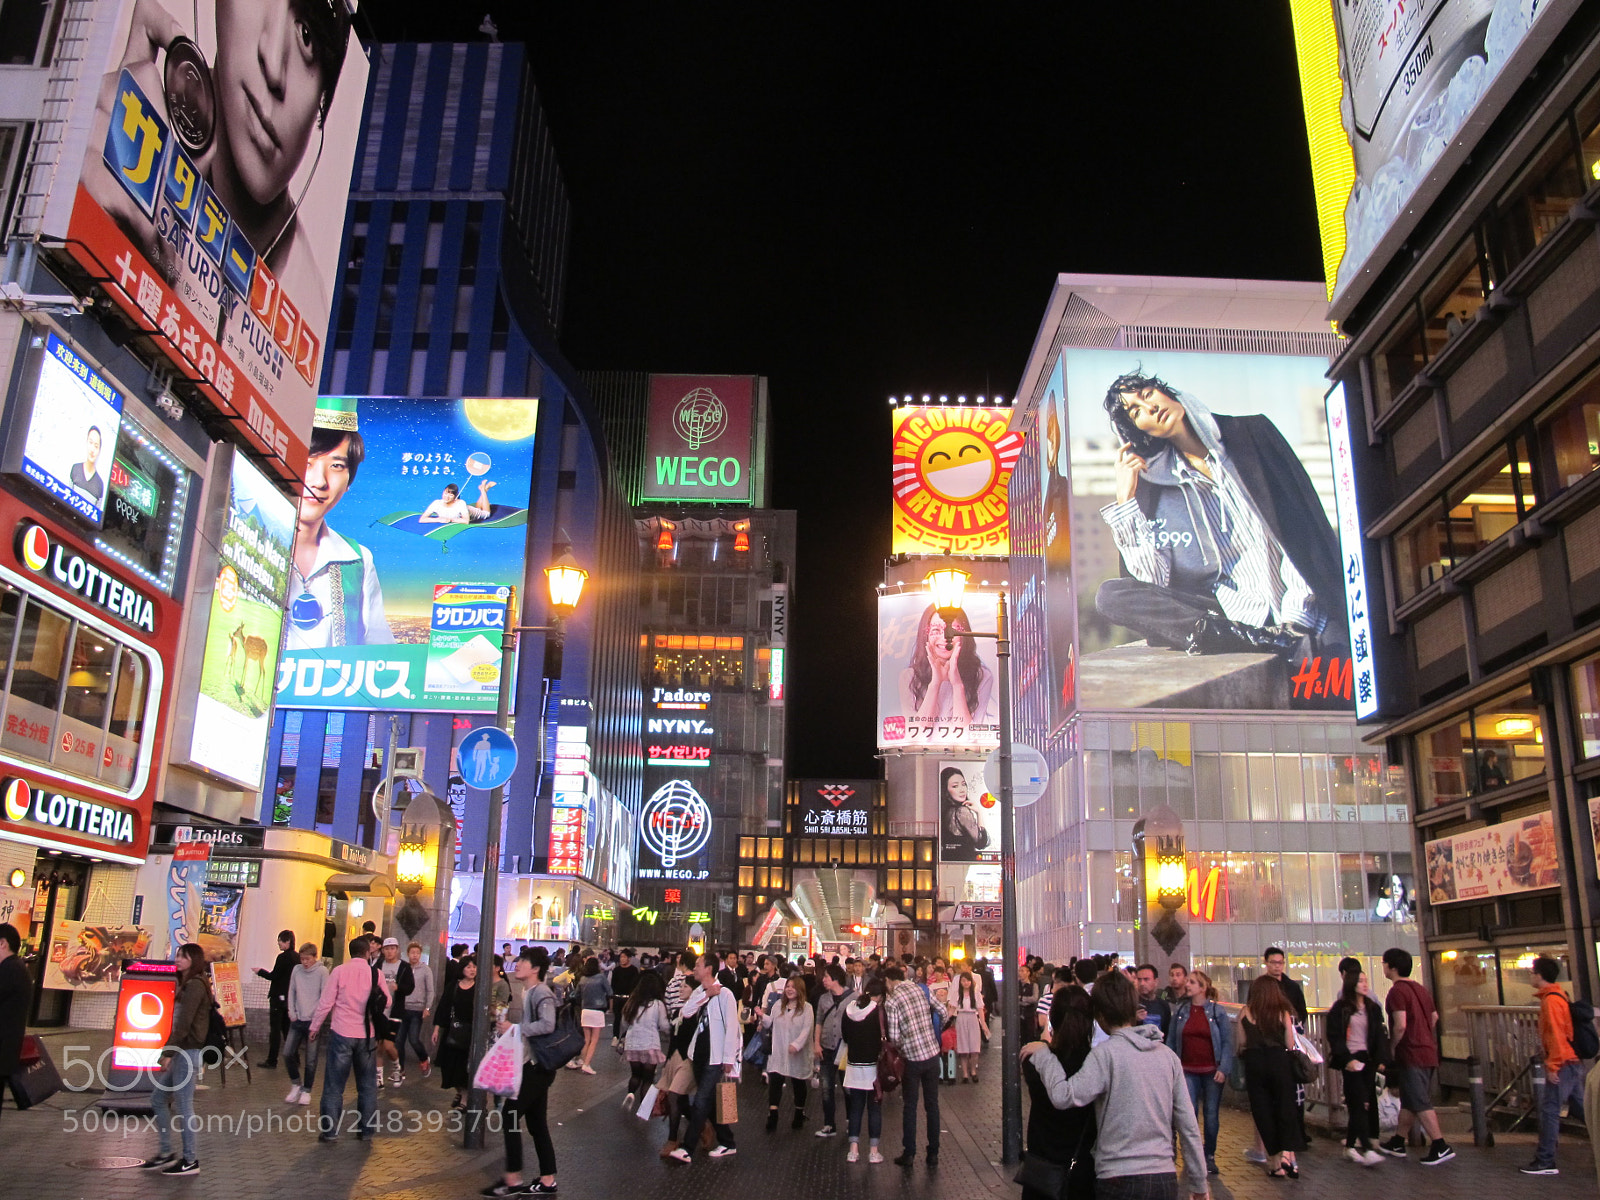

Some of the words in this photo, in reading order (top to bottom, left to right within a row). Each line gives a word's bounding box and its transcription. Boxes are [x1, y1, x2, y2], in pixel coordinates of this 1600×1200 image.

[1403, 34, 1434, 95] 350ml
[157, 206, 239, 320] SATURDAY
[241, 311, 272, 365] PLUS
[894, 408, 1007, 460] NICONICO
[402, 452, 456, 463] 夢のような、
[402, 465, 456, 476] きもちよさ。
[655, 456, 741, 487] WEGO
[229, 506, 259, 549] Travel
[264, 539, 286, 573] Nara
[1135, 531, 1193, 550] ¥1,999
[223, 543, 234, 558] on
[53, 545, 154, 633] LOTTERIA
[436, 606, 504, 627] サロンパス
[774, 595, 784, 636] NYNY
[1346, 553, 1373, 704] かに道楽
[1291, 656, 1352, 700] H&M
[652, 687, 711, 703] J'adore
[908, 726, 964, 739] ワクワク
[648, 745, 711, 760] サイゼリヤ
[35, 789, 134, 843] LOTTERIA
[804, 808, 868, 826] 心斎橋筋
[195, 829, 244, 844] Toilets
[551, 833, 564, 867] コミック
[566, 808, 580, 868] インターネット
[804, 825, 819, 834] SHIN
[349, 848, 367, 864] Toilets
[639, 868, 709, 880] WWW.WEGO.JP
[664, 888, 681, 904] 薬
